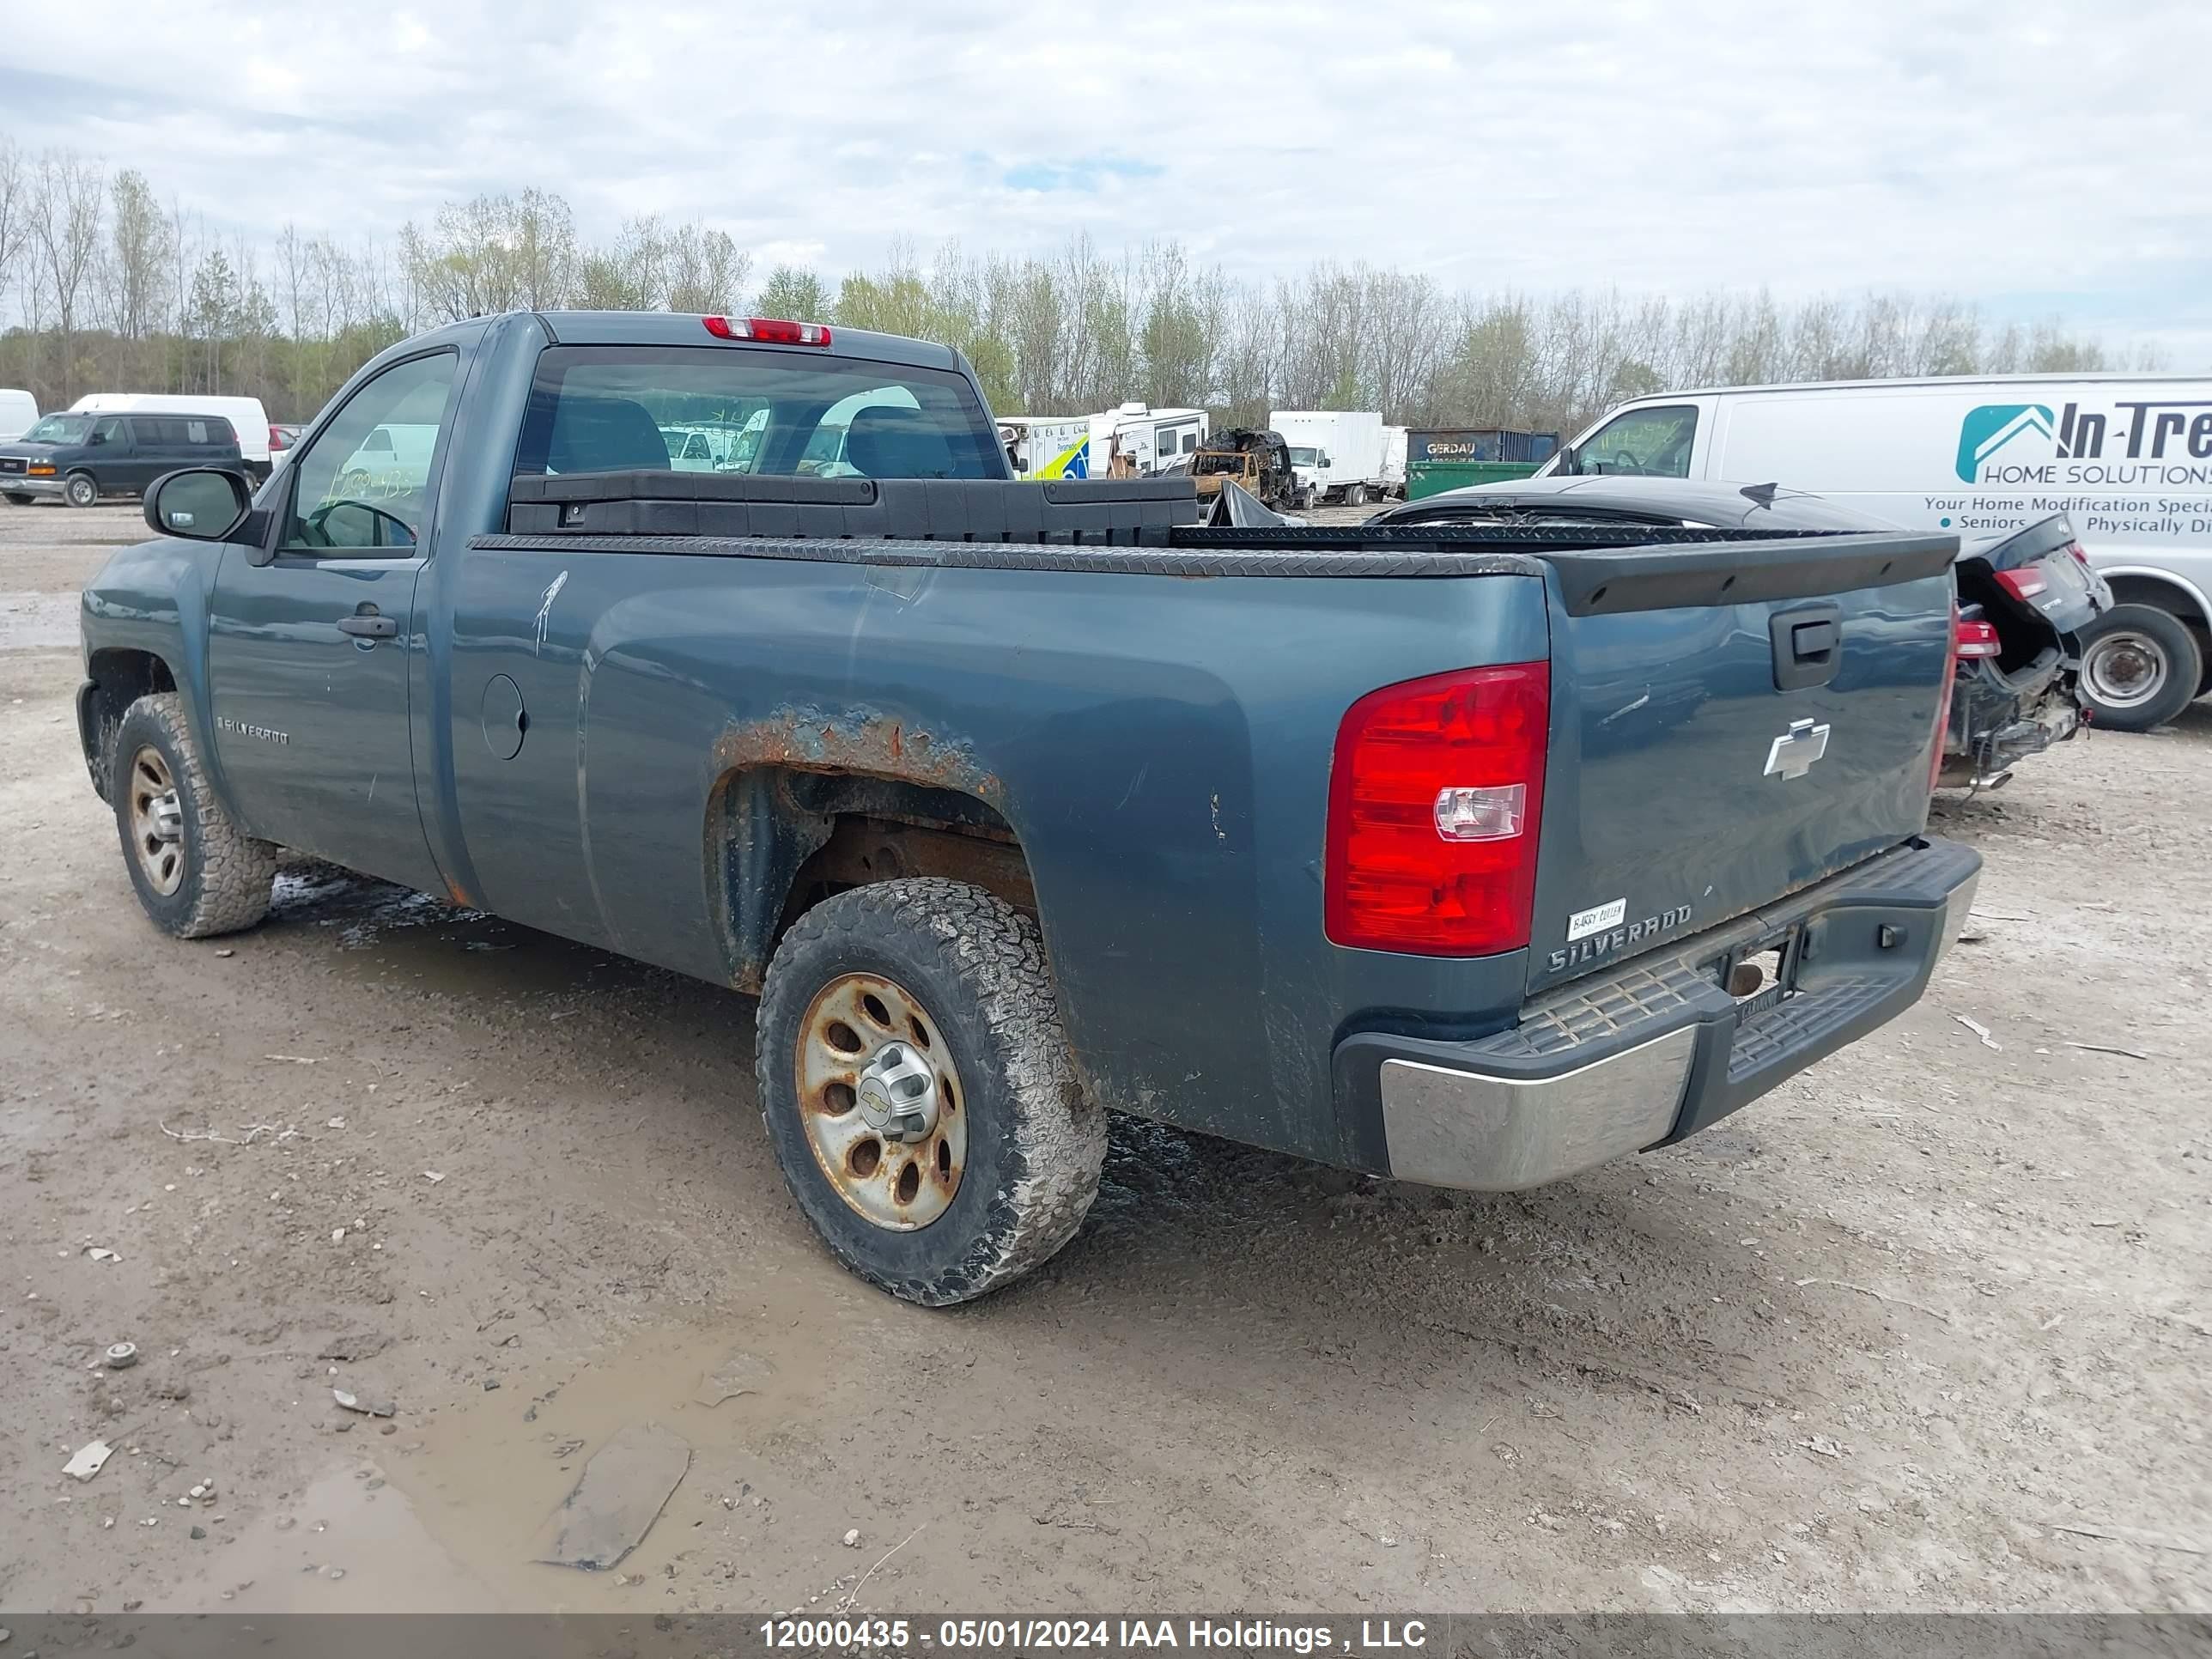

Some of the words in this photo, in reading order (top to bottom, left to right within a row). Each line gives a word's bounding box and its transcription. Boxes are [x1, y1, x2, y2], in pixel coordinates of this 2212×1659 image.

[1426, 442, 1476, 454] GERDAU
[1984, 465, 2057, 484] HOME
[2066, 465, 2212, 484] SOLUTION
[1925, 497, 1966, 511] Your
[1972, 497, 2025, 511] Home
[2032, 497, 2149, 513] Modification
[2158, 498, 2212, 516] Speci
[2087, 516, 2185, 536] Physically
[224, 719, 290, 746] SILVERADO
[1573, 913, 1596, 931] BARRY
[1600, 905, 1622, 922] CULLEN
[1547, 904, 1692, 974] SILVERADO
